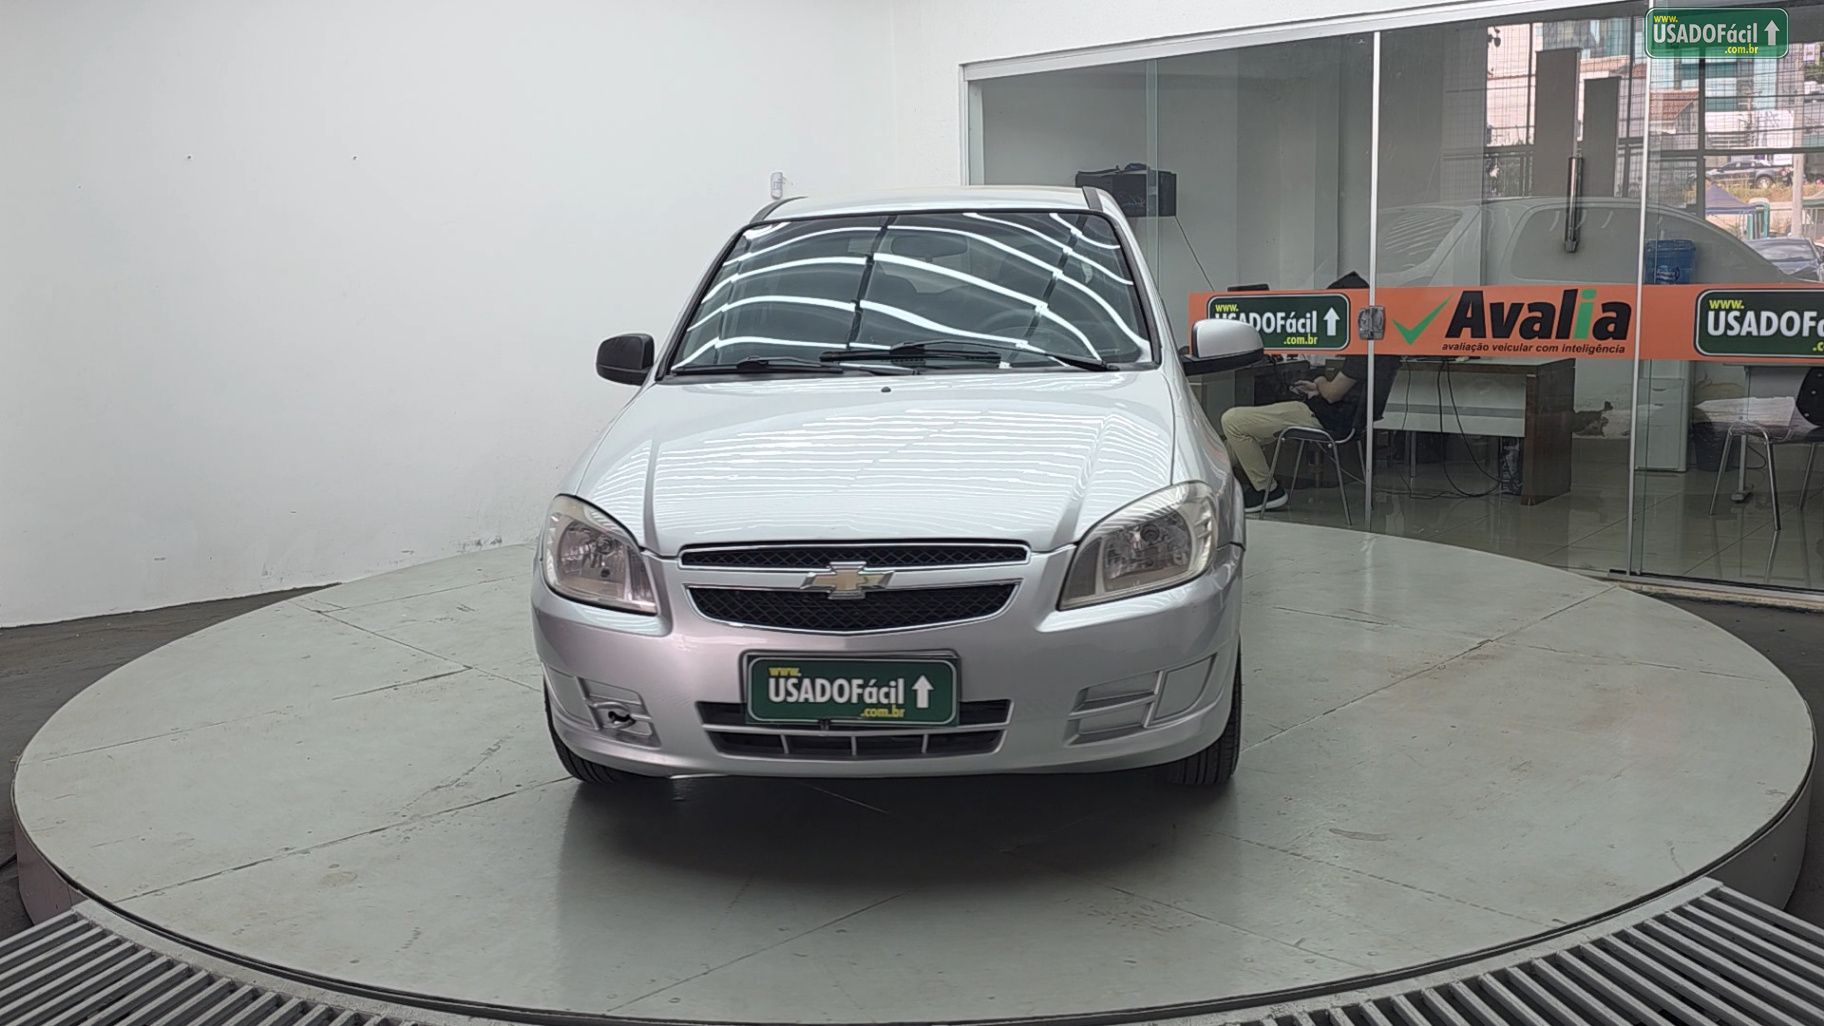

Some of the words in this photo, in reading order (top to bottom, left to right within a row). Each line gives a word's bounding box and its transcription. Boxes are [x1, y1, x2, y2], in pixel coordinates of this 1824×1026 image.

[1215, 304, 1239, 312] www.
[1709, 300, 1745, 309] www.
[1445, 288, 1632, 341] Avalia
[1283, 333, 1318, 345] .com.br
[1442, 342, 1489, 352] avaliação
[1492, 343, 1533, 352] veicular
[1535, 344, 1559, 353] com
[1562, 344, 1625, 355] inteligência
[769, 667, 801, 676] www.
[768, 678, 904, 704] USADOFácil
[861, 705, 904, 718] .com.br
